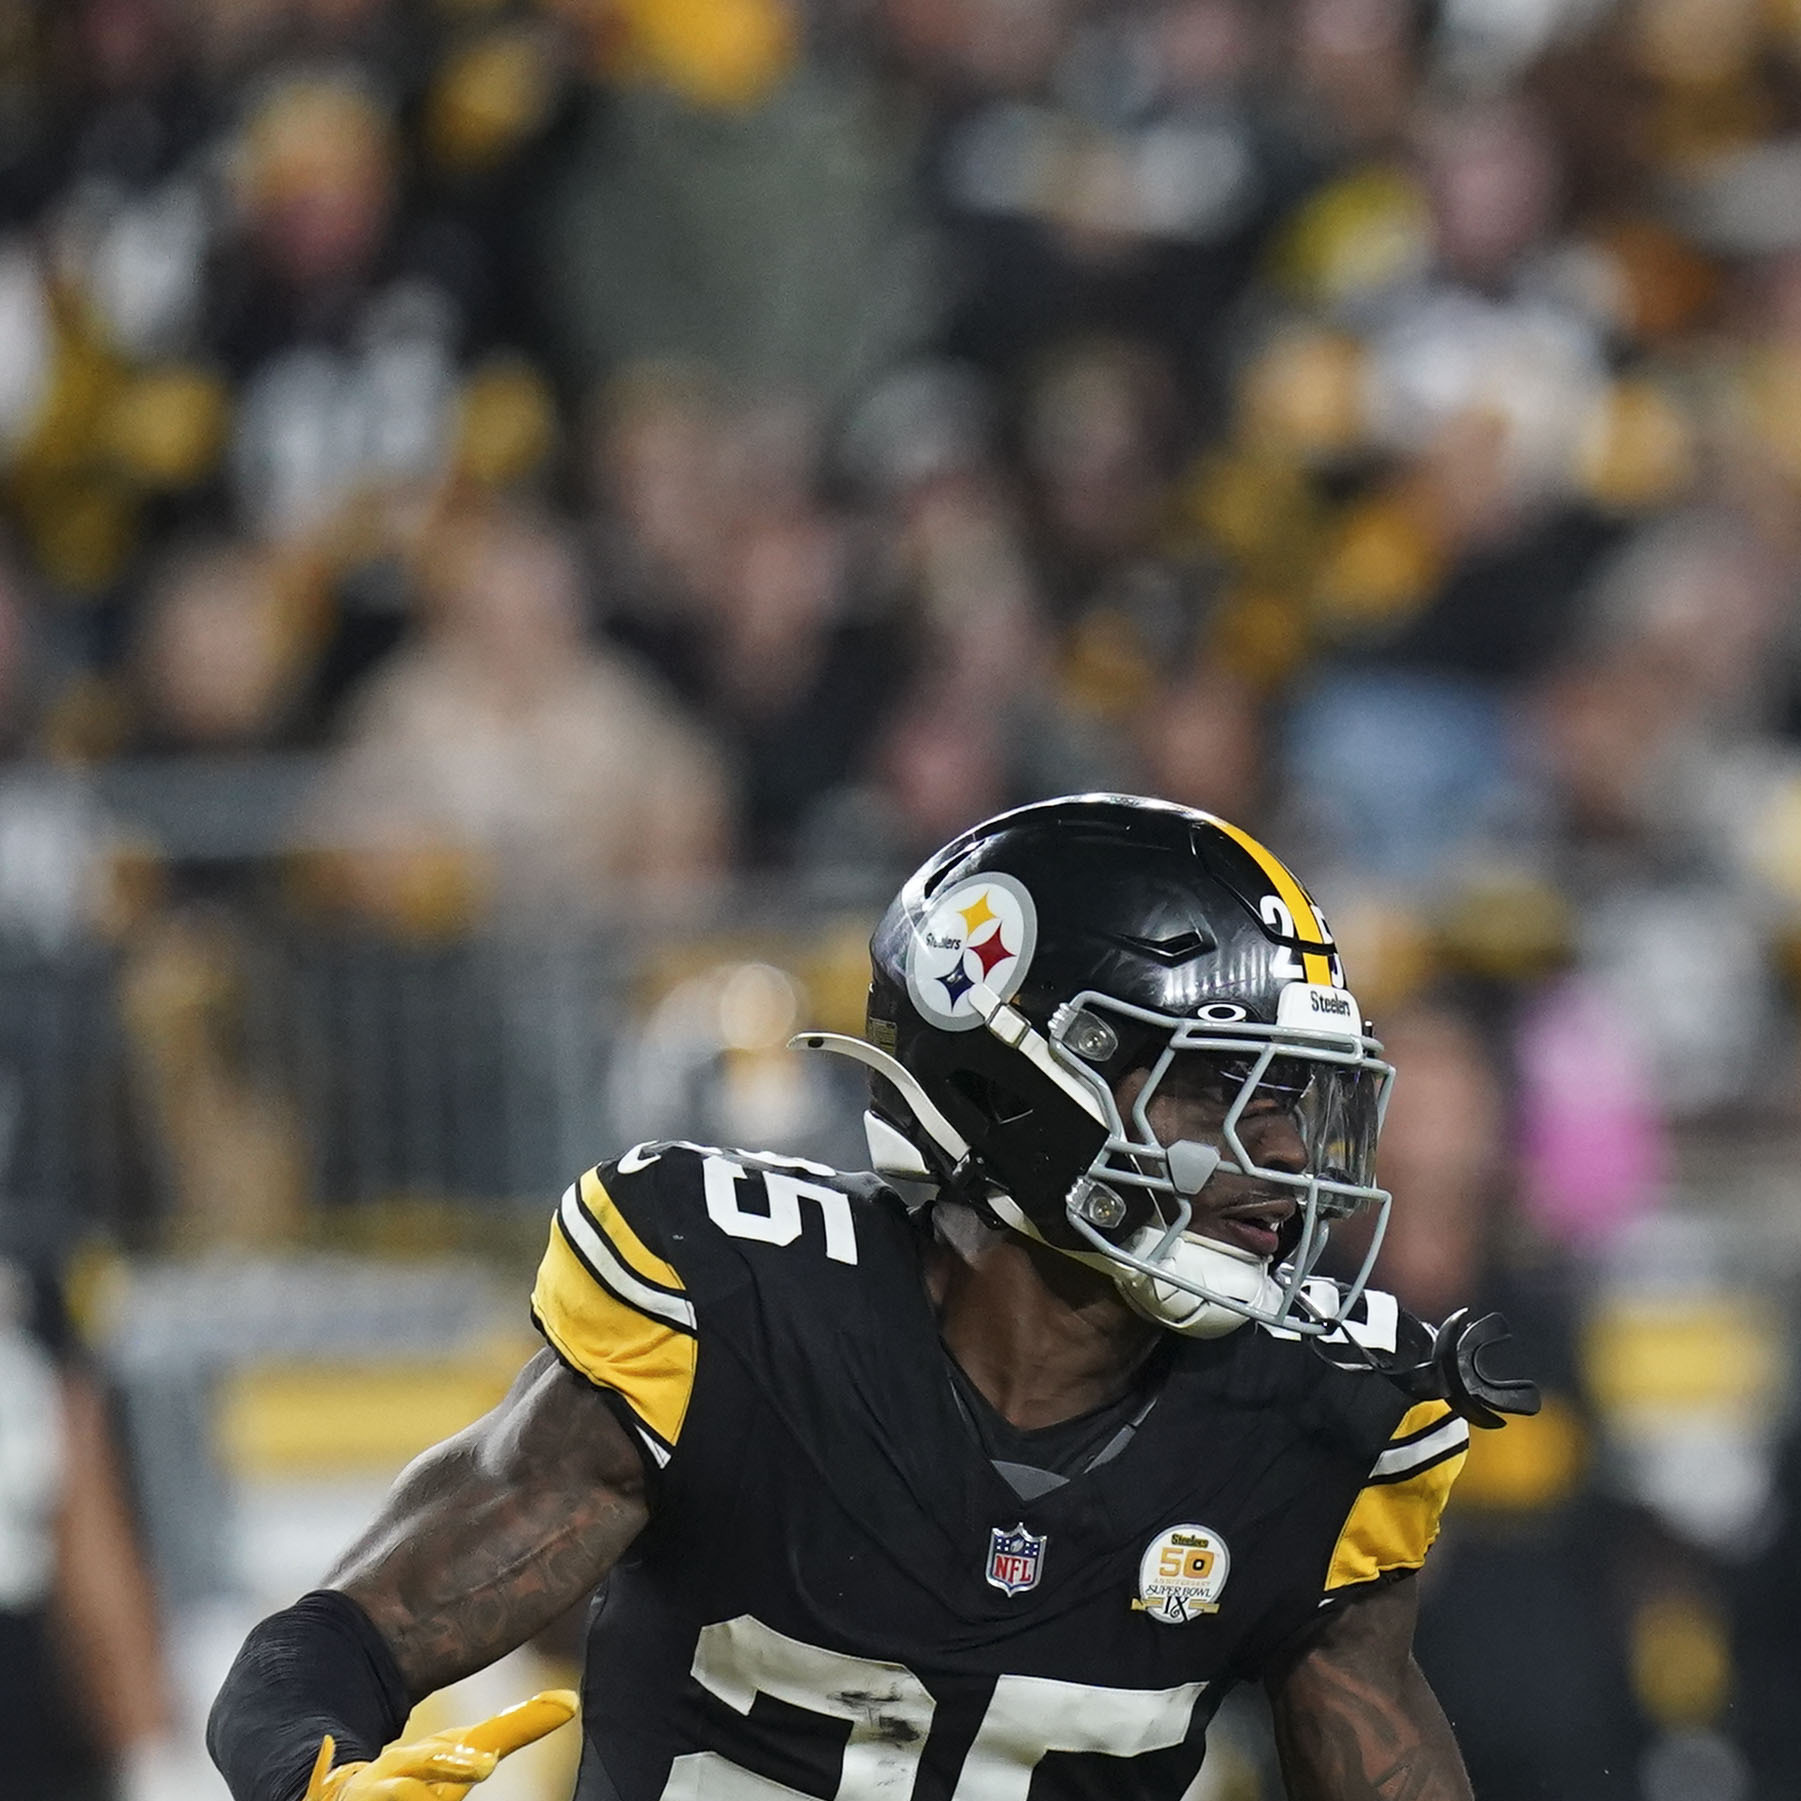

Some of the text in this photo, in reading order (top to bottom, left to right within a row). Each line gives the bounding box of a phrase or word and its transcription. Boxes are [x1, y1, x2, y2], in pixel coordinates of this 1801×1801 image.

[994, 1554, 1032, 1584] NFL
[1159, 1547, 1215, 1579] 50
[1145, 1584, 1212, 1599] SUPER BOWL
[1163, 1595, 1190, 1621] IX
